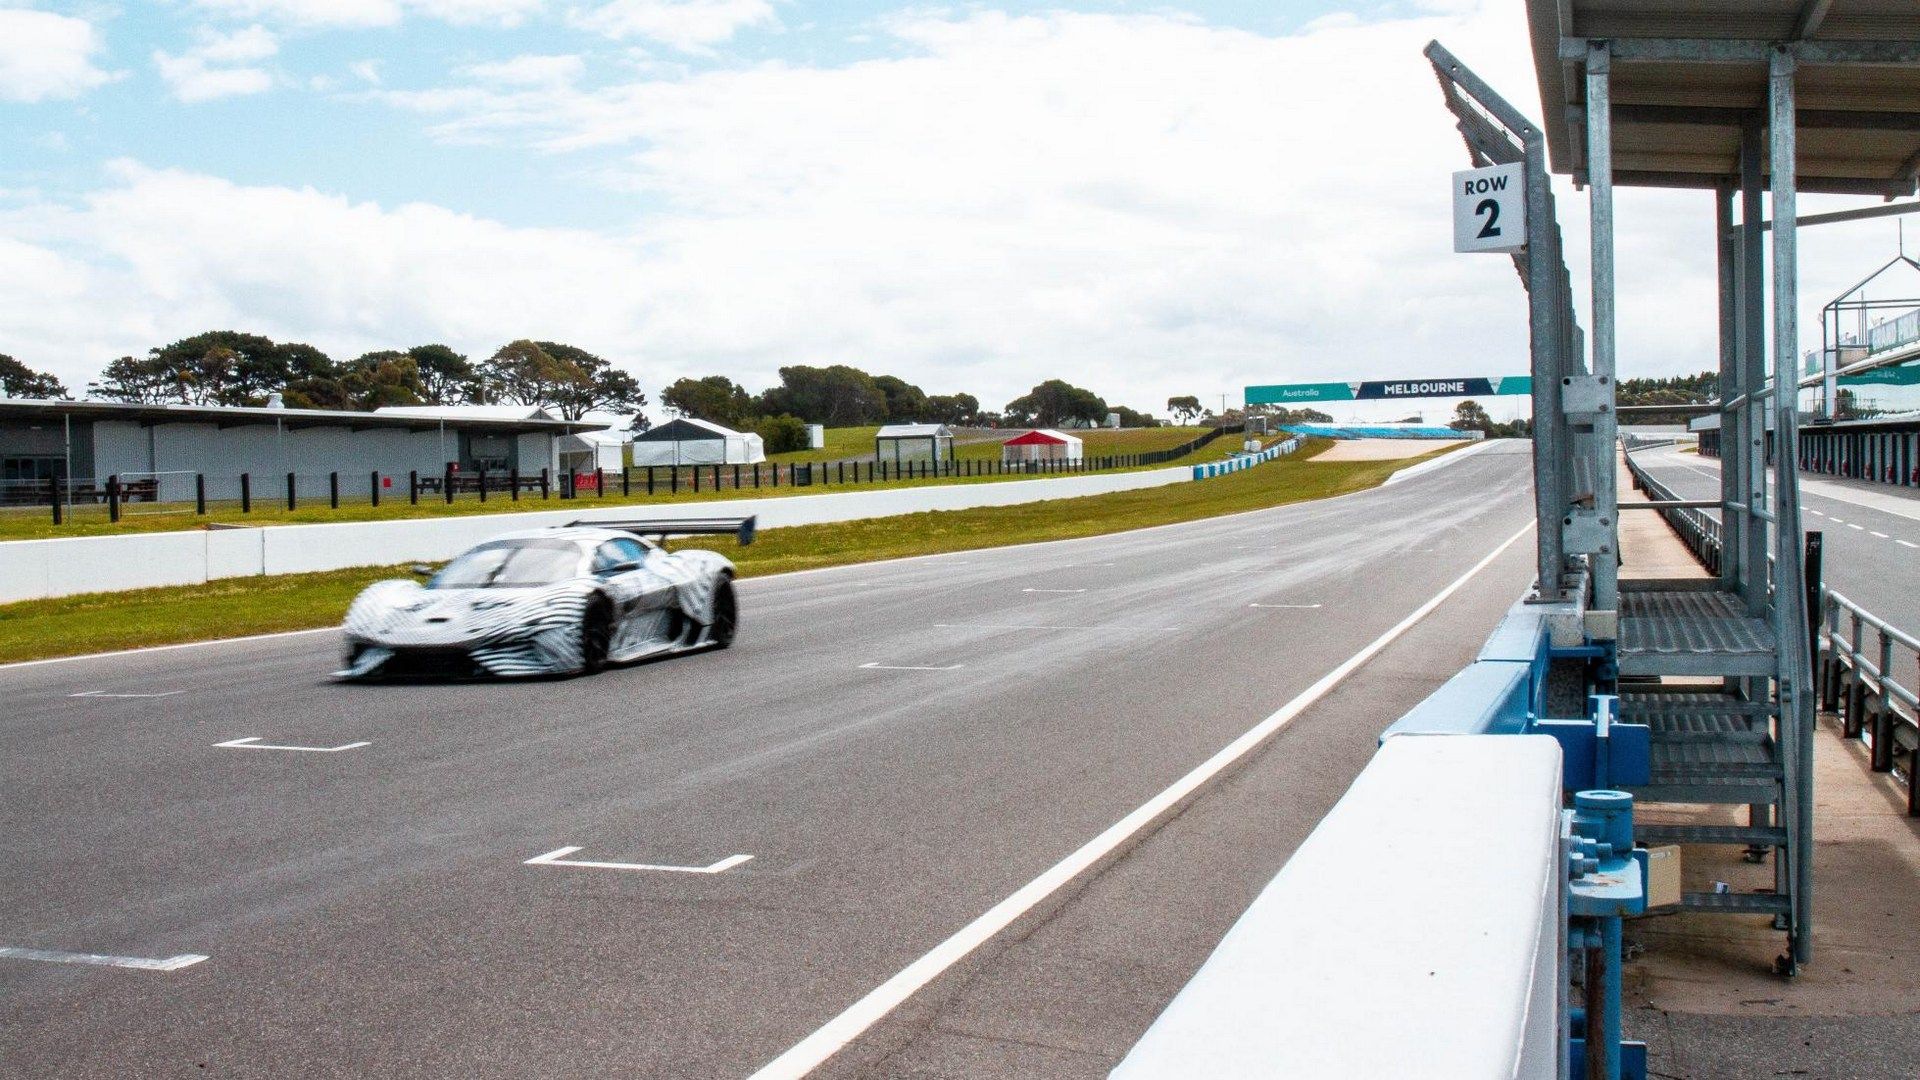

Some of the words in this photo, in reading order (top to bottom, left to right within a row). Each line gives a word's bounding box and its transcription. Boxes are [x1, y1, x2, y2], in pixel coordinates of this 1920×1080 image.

[1464, 175, 1508, 195] ROW
[1475, 198, 1501, 239] 2
[1283, 388, 1319, 397] Australia
[1384, 382, 1465, 395] MELBOURNE
